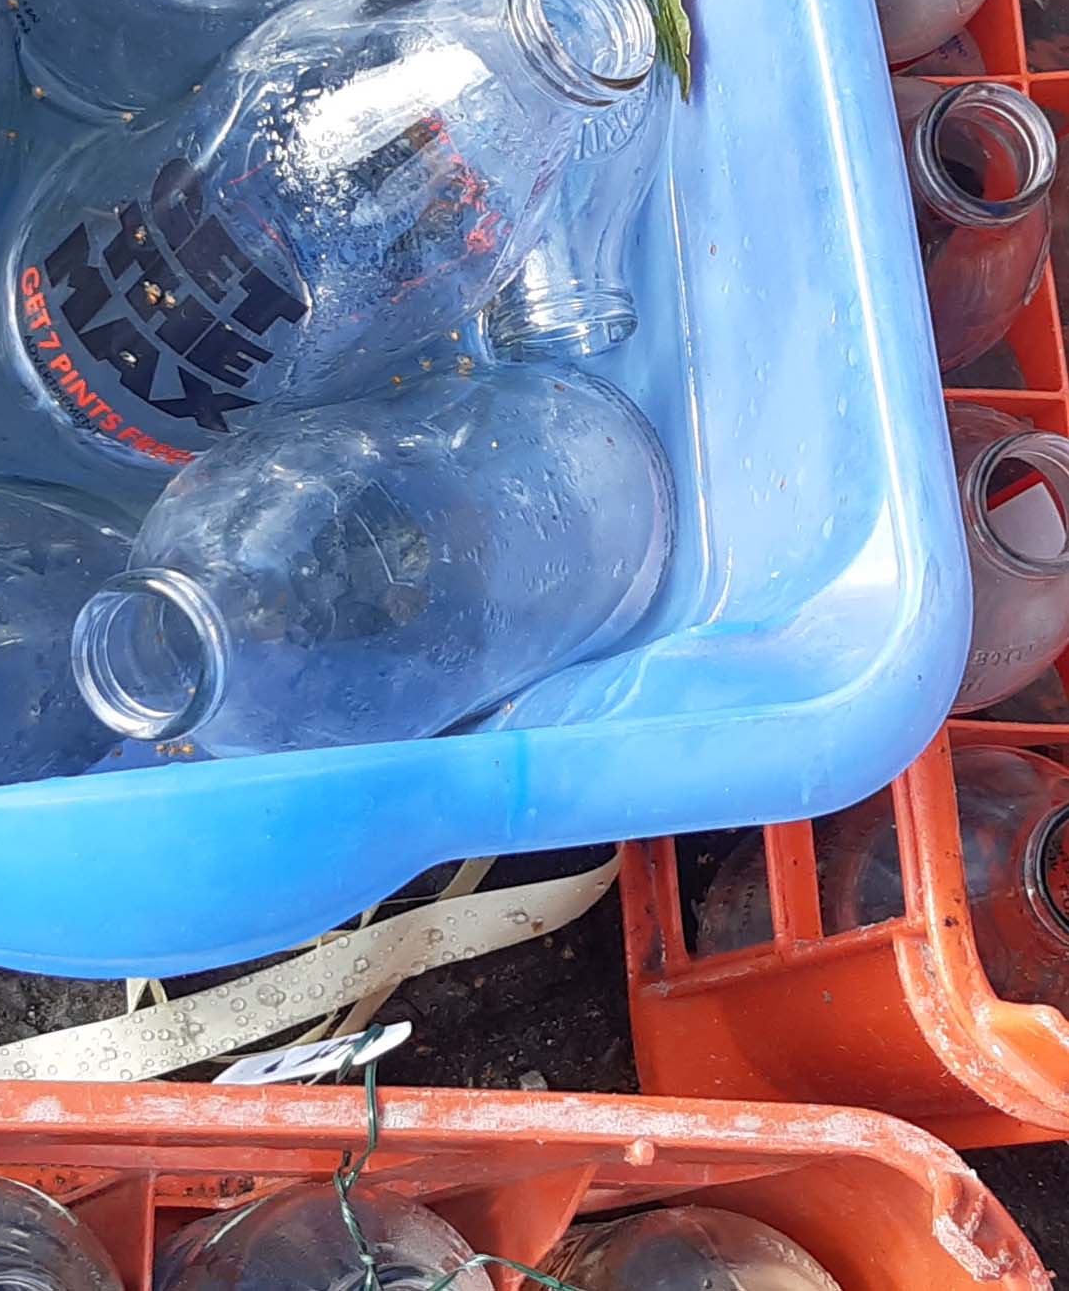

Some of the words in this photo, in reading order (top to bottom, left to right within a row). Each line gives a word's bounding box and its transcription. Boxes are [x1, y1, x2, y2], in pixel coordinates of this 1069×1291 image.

[20, 266, 53, 332] GET
[43, 221, 261, 434] MAX
[102, 197, 275, 389] THE
[24, 334, 104, 439] ADVERTISEMENT
[37, 331, 62, 352] 7
[49, 353, 124, 432] PINTS
